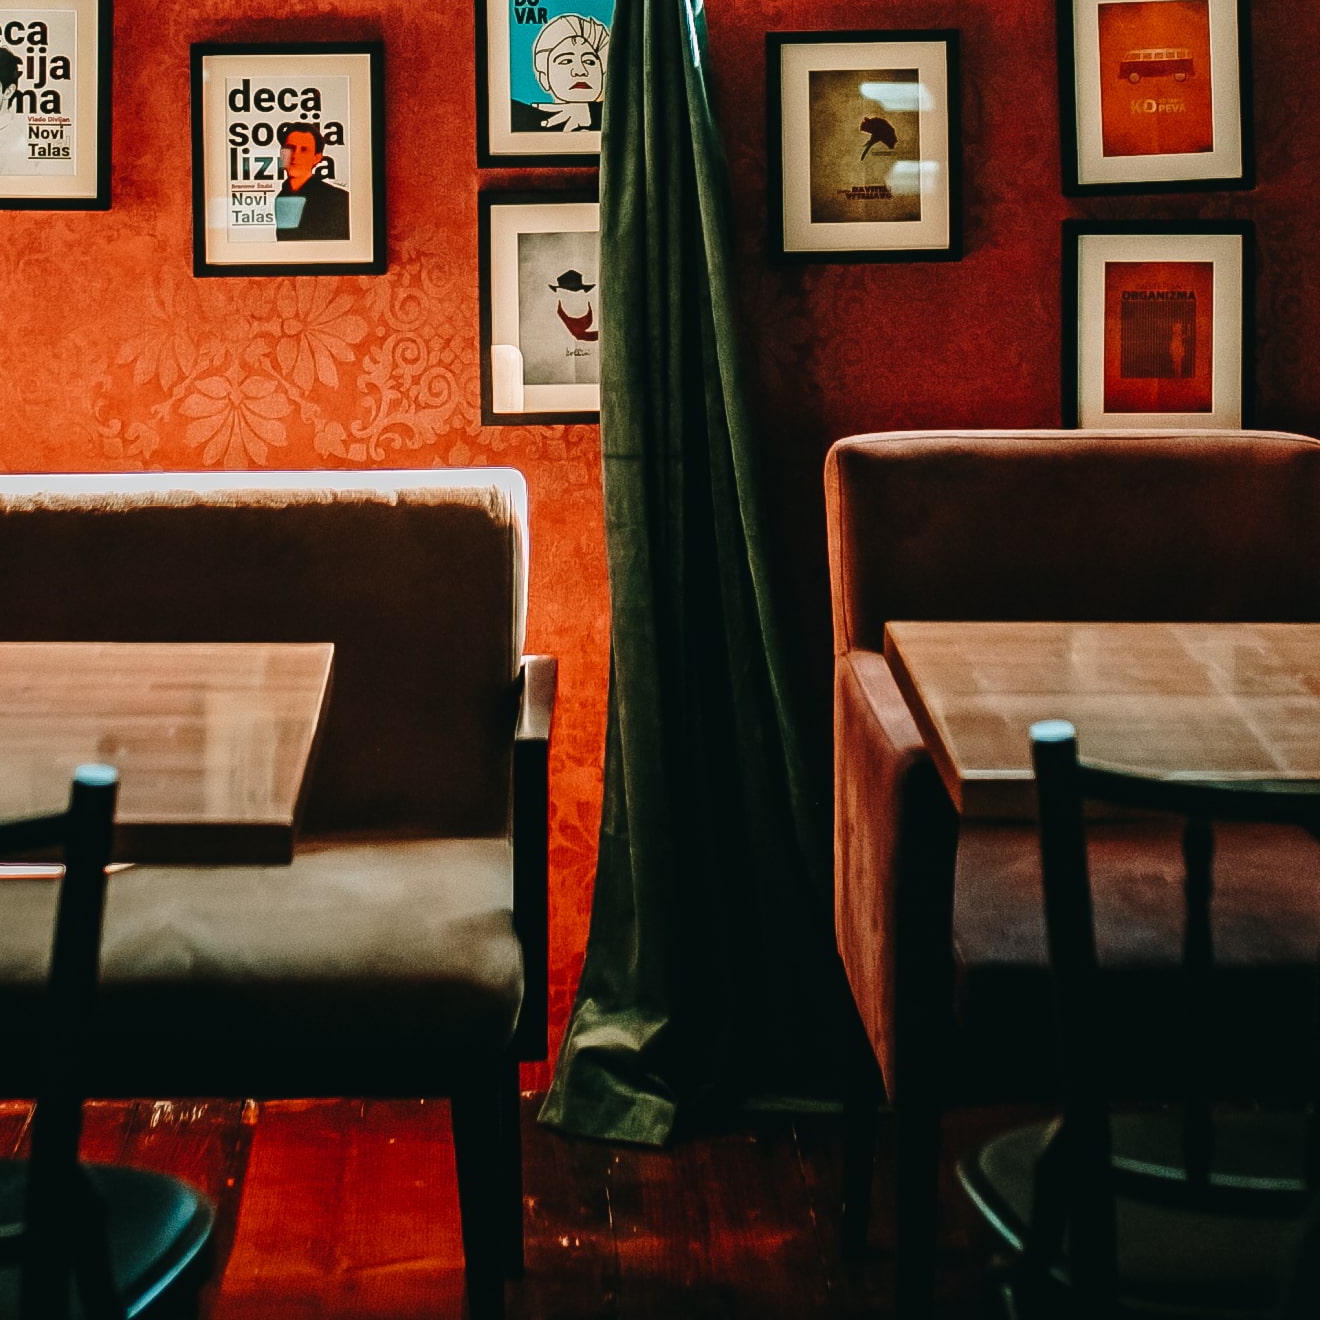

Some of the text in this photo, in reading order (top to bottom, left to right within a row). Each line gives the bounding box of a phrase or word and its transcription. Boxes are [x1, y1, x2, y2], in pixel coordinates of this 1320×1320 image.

[514, 7, 548, 25] VAR
[228, 79, 322, 112] deca
[29, 126, 64, 139] Novi
[28, 143, 70, 157] Talas
[232, 192, 267, 206] Novi
[232, 210, 274, 223] Talas
[1122, 290, 1196, 300] ORGANIZMA
